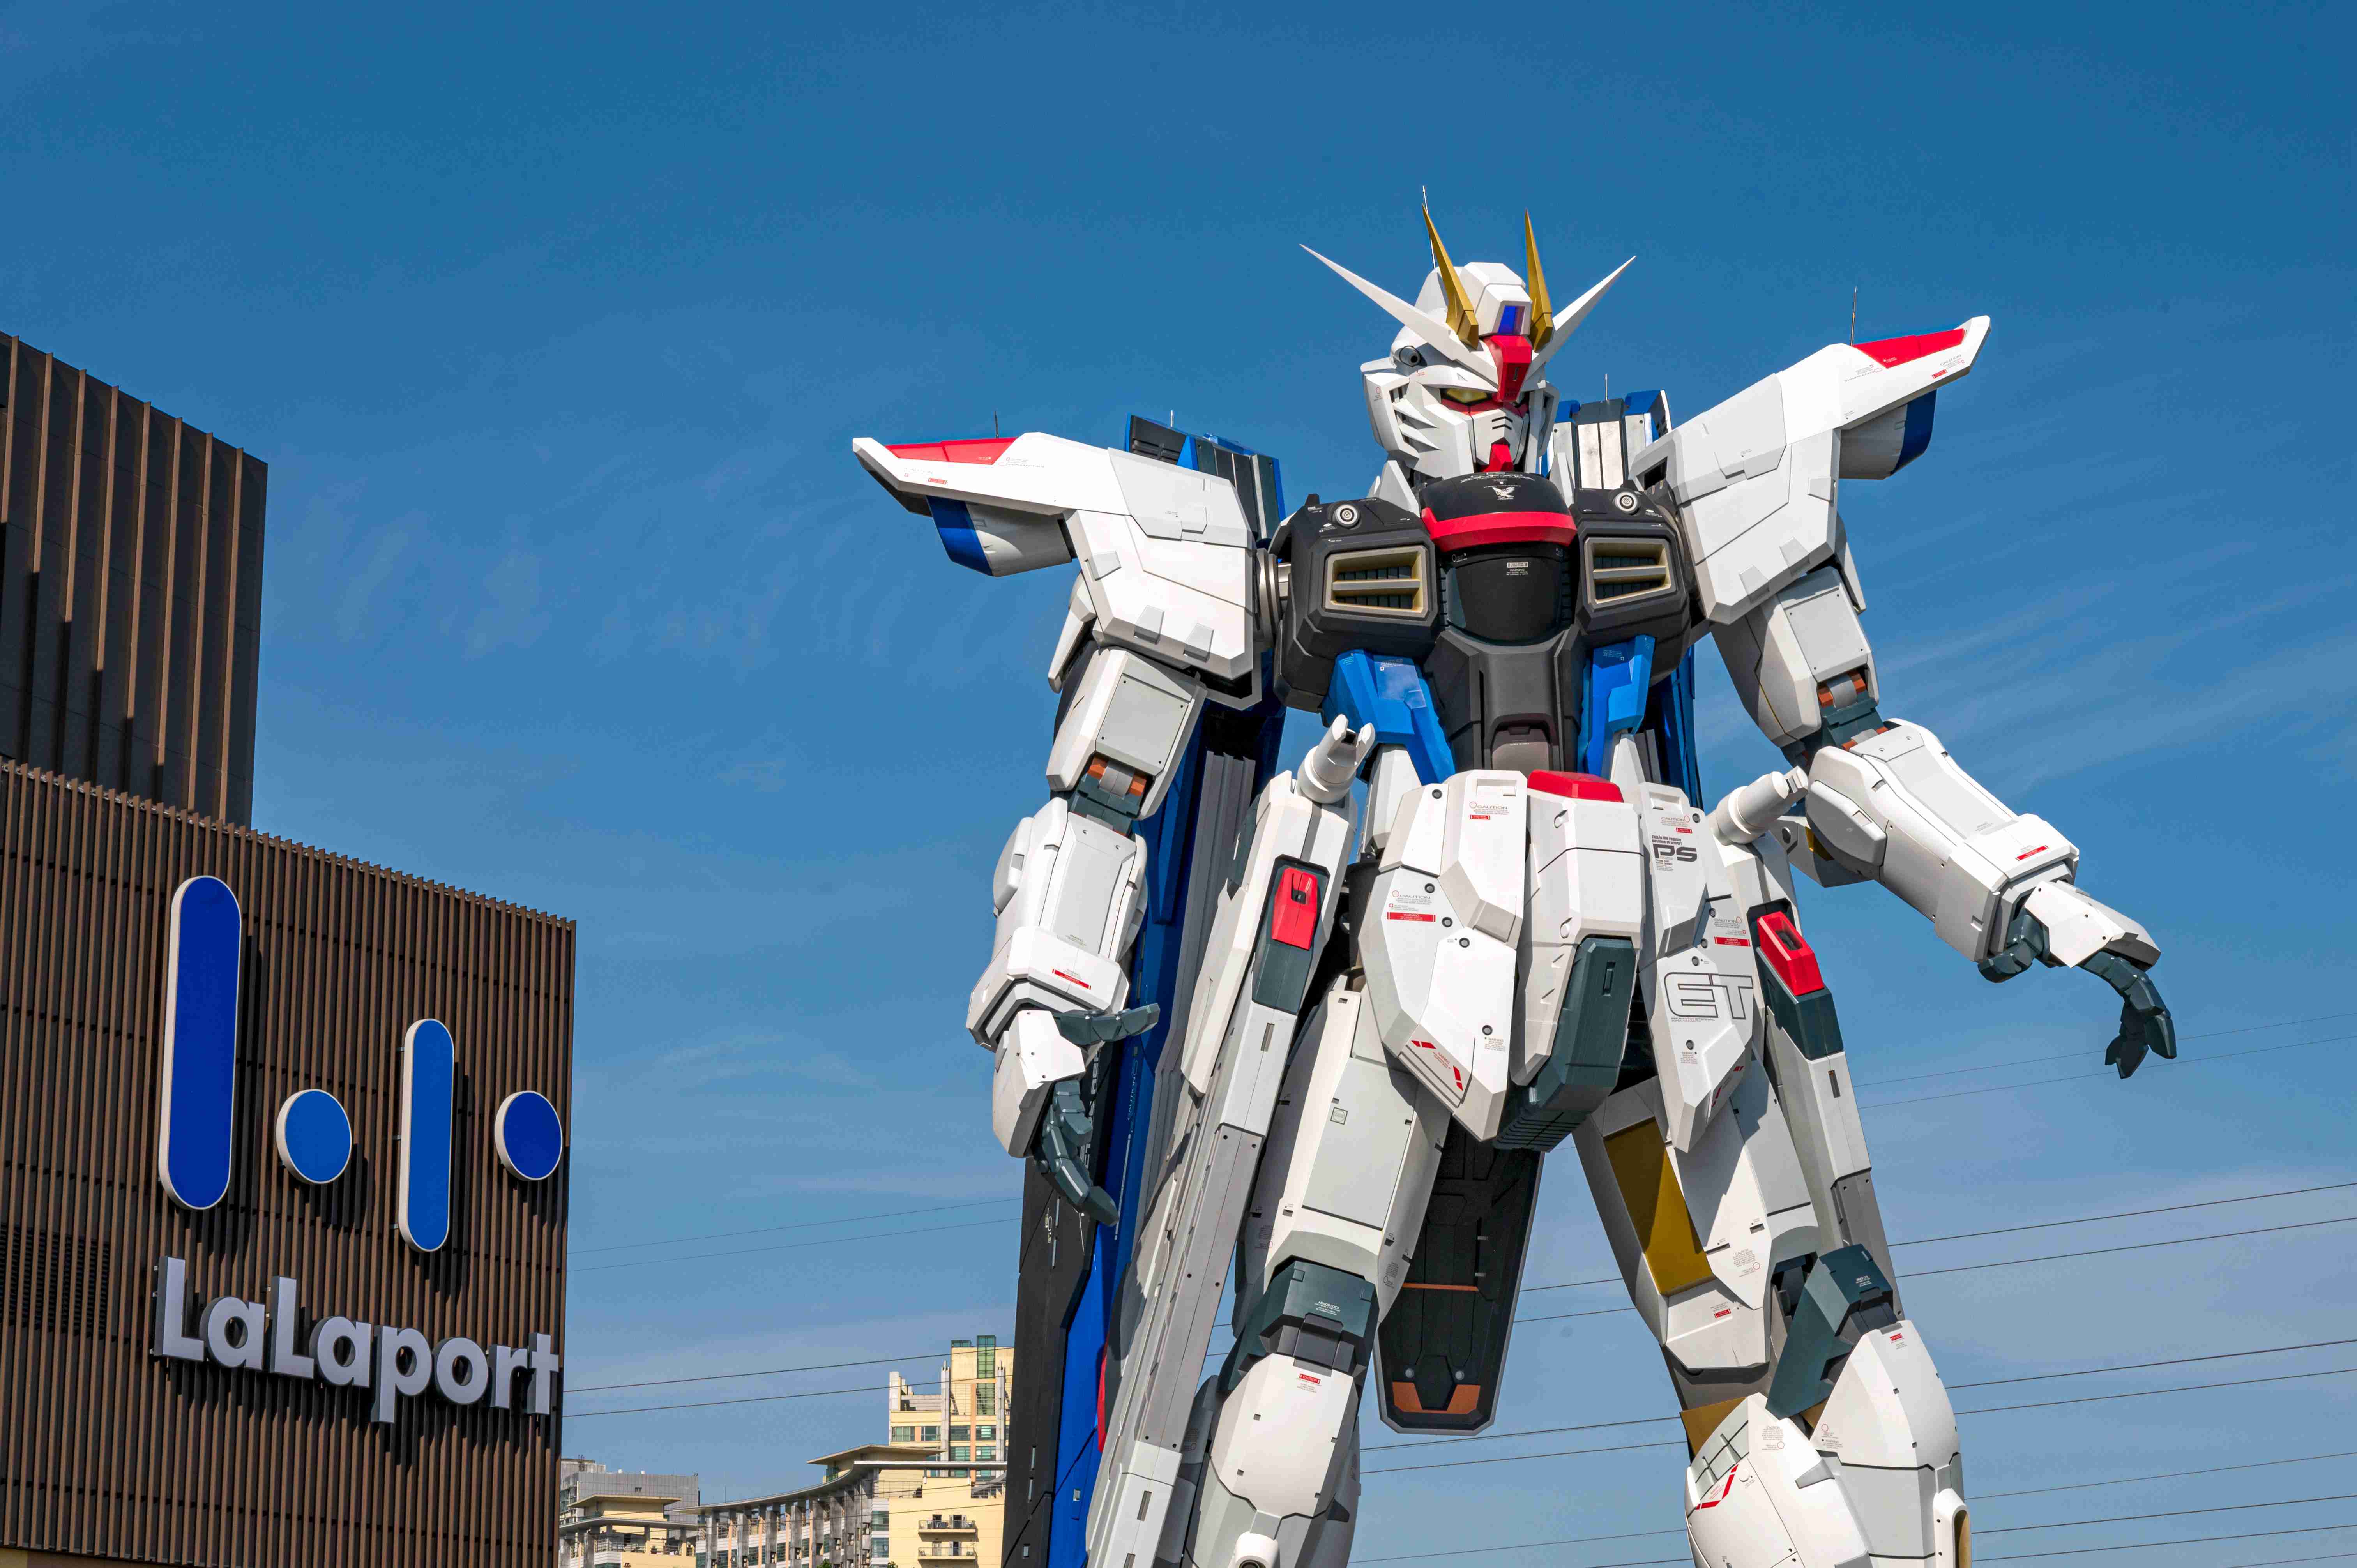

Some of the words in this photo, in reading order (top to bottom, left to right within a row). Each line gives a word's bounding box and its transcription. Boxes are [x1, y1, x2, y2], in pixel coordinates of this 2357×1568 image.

[1653, 844, 1698, 862] PS
[1664, 972, 1754, 1020] ET
[157, 1256, 559, 1423] LaLaport
